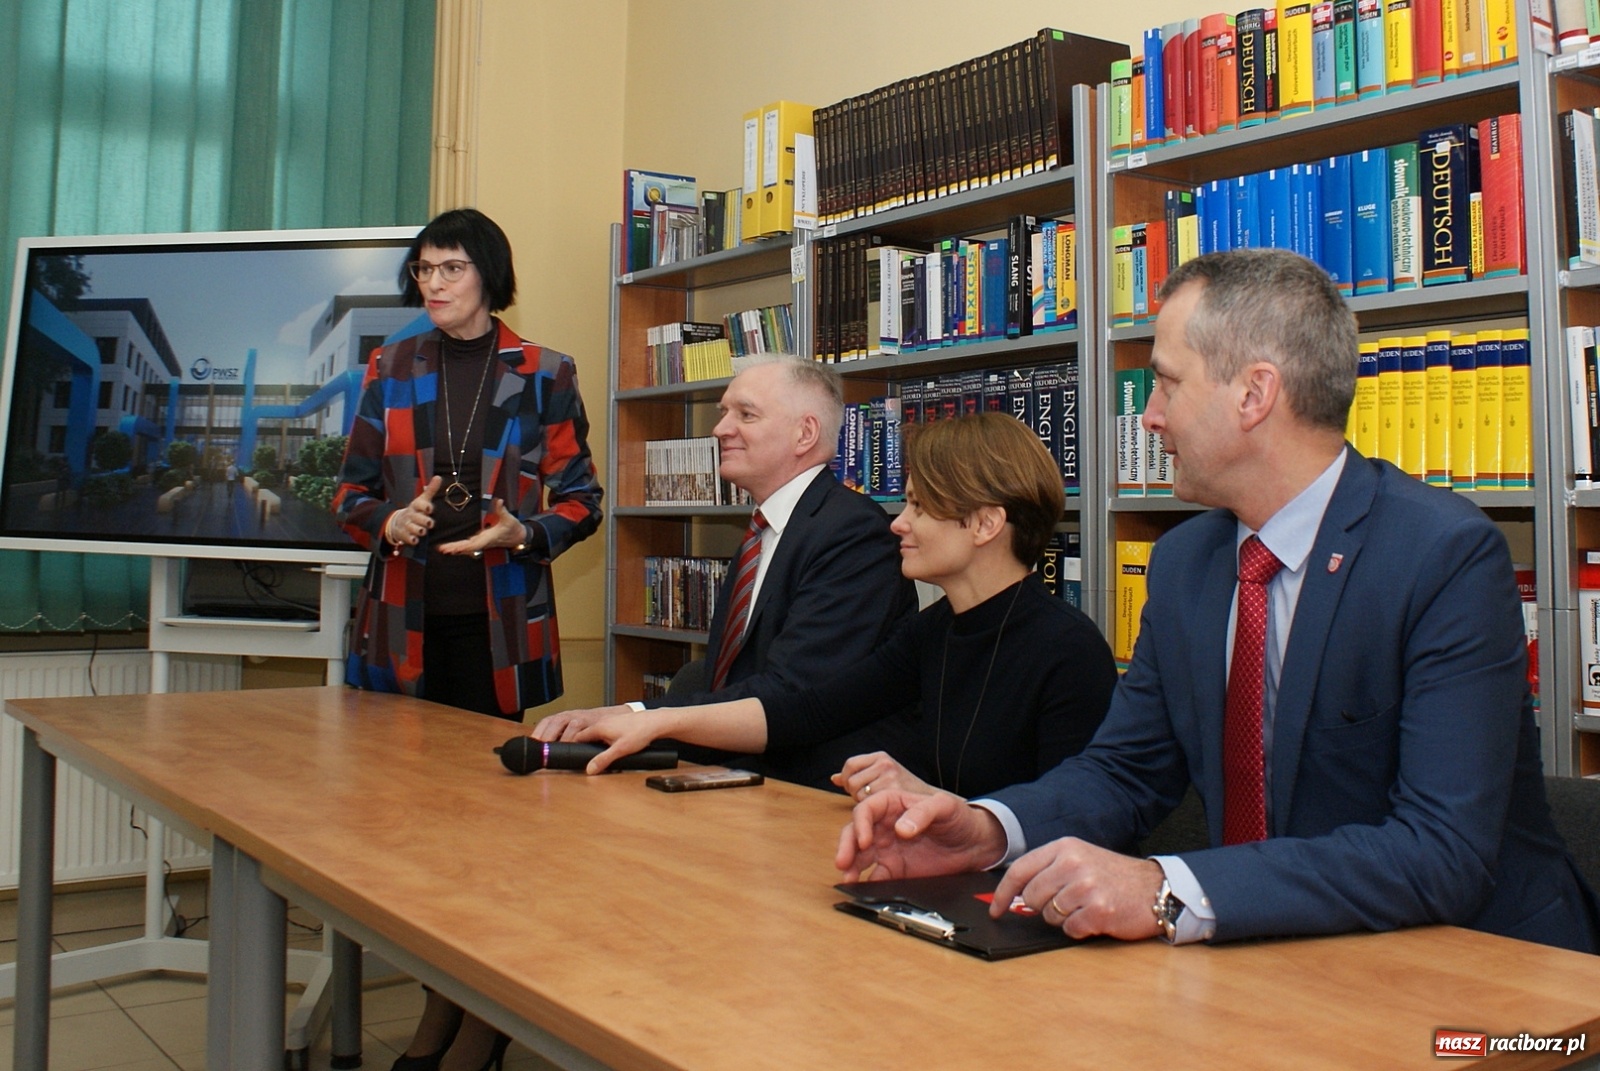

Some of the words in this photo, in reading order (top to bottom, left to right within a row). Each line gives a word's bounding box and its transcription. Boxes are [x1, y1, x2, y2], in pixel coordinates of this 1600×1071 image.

[1285, 6, 1306, 16] DUDEN
[1359, 11, 1378, 21] DUDEN
[1388, 2, 1407, 12] DUDEN
[1202, 37, 1216, 48] DUDE
[1242, 32, 1255, 112] DEUTSCH
[1394, 159, 1409, 198] słownik
[1392, 201, 1401, 262] polsko-niemiecki
[1432, 152, 1452, 265] DEUTSCH
[1498, 206, 1506, 260] Wörterbuch
[1400, 198, 1414, 273] naukowo-techniczny
[967, 252, 975, 330] LEXICUS
[1011, 255, 1019, 286] SLANG
[213, 368, 238, 377] PWSZ
[1379, 350, 1400, 358] DUDEN
[1124, 381, 1136, 415] słownik
[848, 408, 856, 466] LONGMAN
[872, 420, 883, 490] Etymology
[893, 419, 901, 468] Advanced
[1064, 390, 1076, 478] ENGLISH
[1119, 417, 1127, 470] niemiecko-polski
[1129, 416, 1140, 481] naukowo-techniczny
[1148, 432, 1156, 470] ecko-polski
